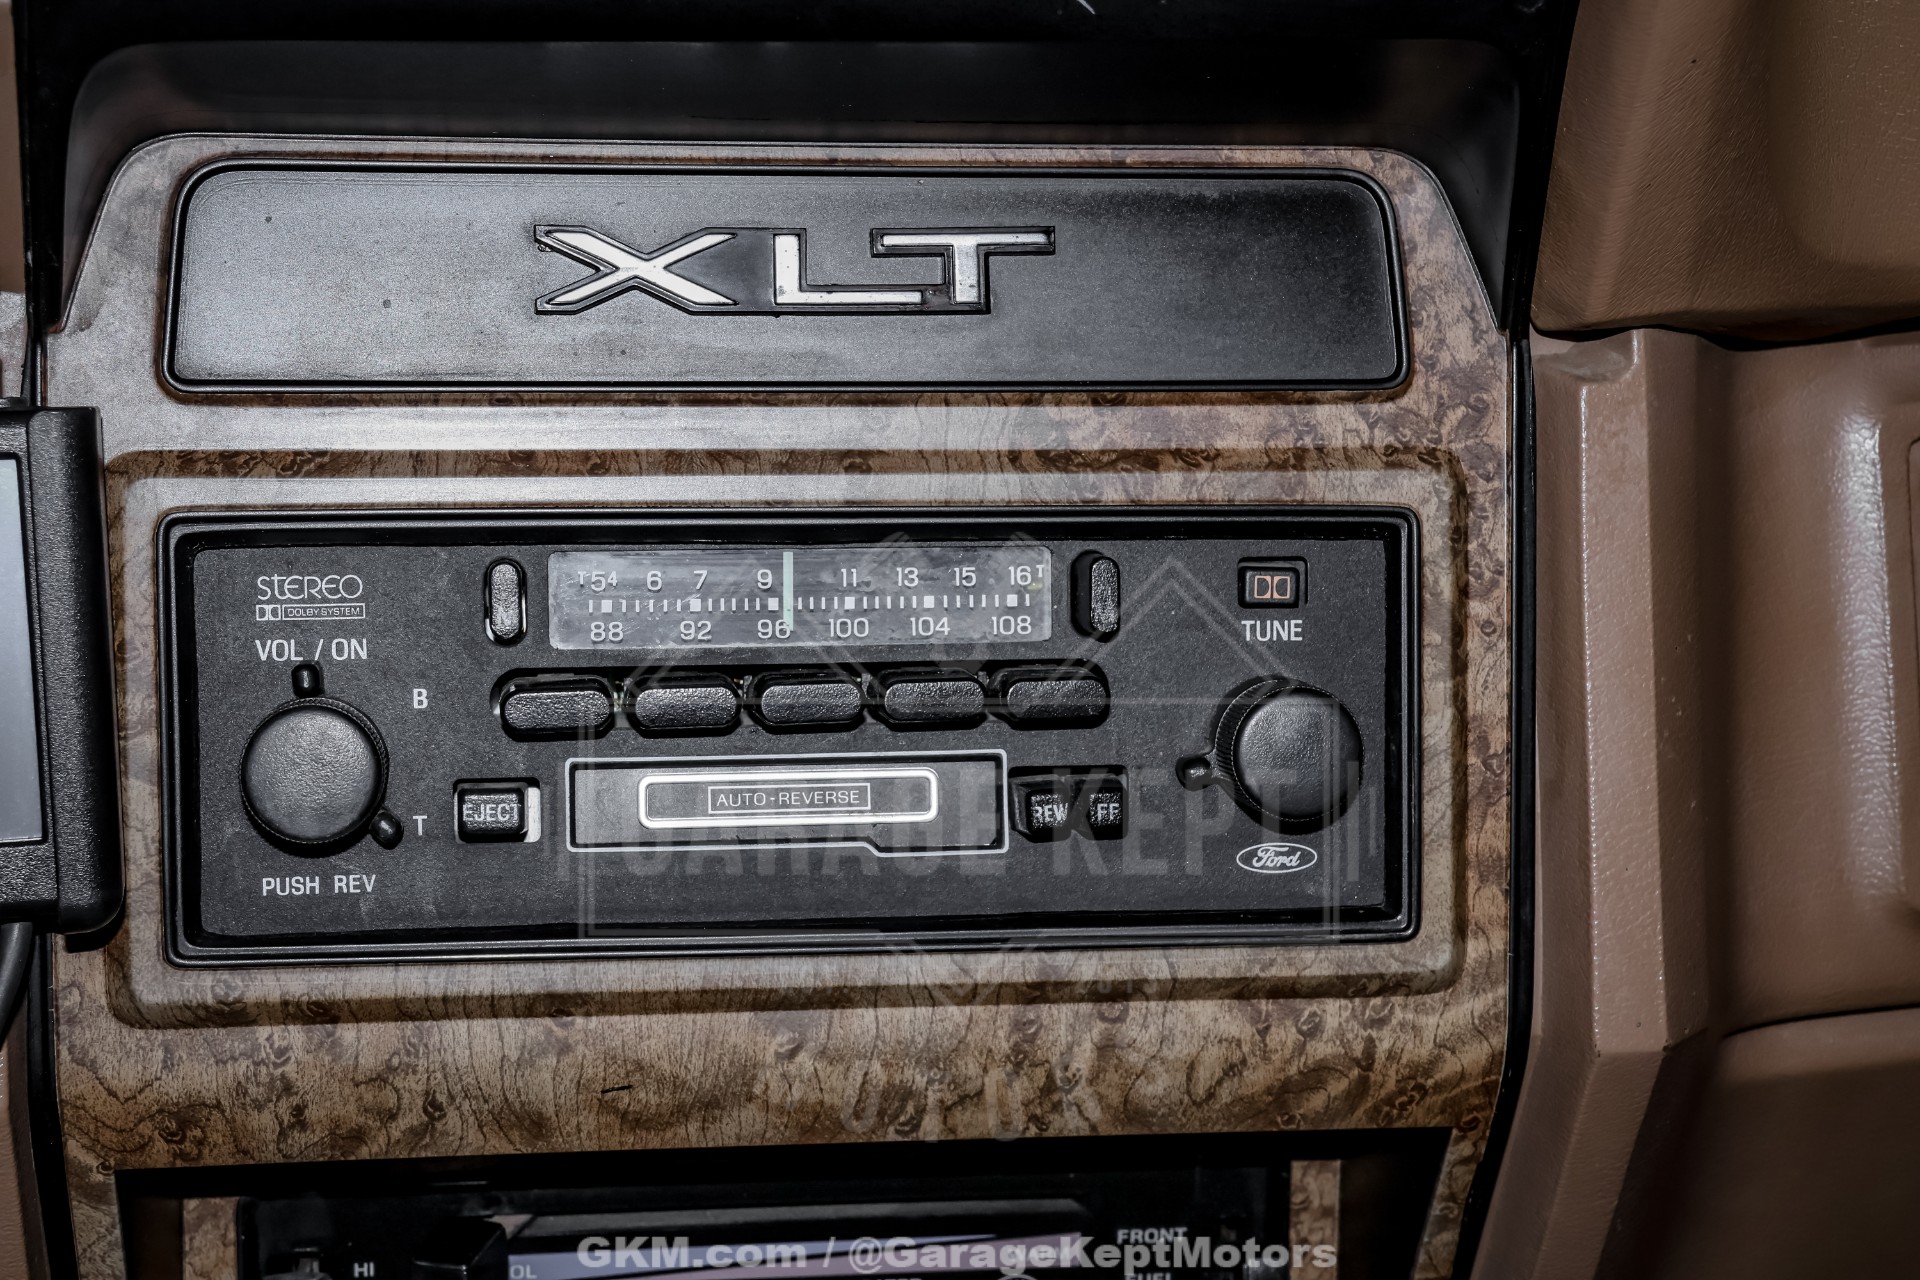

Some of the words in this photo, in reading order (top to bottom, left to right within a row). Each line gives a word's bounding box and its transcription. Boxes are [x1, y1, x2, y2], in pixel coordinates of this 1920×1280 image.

[536, 226, 1055, 313] XLT
[646, 570, 662, 591] 6
[694, 570, 708, 590] 7
[757, 569, 773, 590] 9
[841, 568, 857, 588] 11
[897, 567, 919, 587] 13
[954, 567, 977, 587] 15
[287, 608, 318, 617] DOLBY
[320, 607, 360, 616] SYSTEM
[590, 621, 624, 642] 88
[680, 620, 712, 641] 92
[757, 619, 791, 639] 96
[829, 618, 869, 637] 100
[910, 617, 951, 636] 104
[992, 615, 1032, 635] 108
[1241, 619, 1303, 641] TUNE
[255, 639, 303, 661] VOL
[331, 638, 367, 660] ON
[413, 688, 428, 708] B
[462, 803, 520, 821] EJECT
[1032, 802, 1069, 822] REW
[1097, 803, 1120, 821] FF
[413, 815, 428, 836] T
[1251, 846, 1301, 868] Ford
[262, 876, 320, 896] PUSH
[334, 874, 376, 894] REV
[1117, 1227, 1188, 1244] FRONT
[353, 1262, 375, 1278] HI
